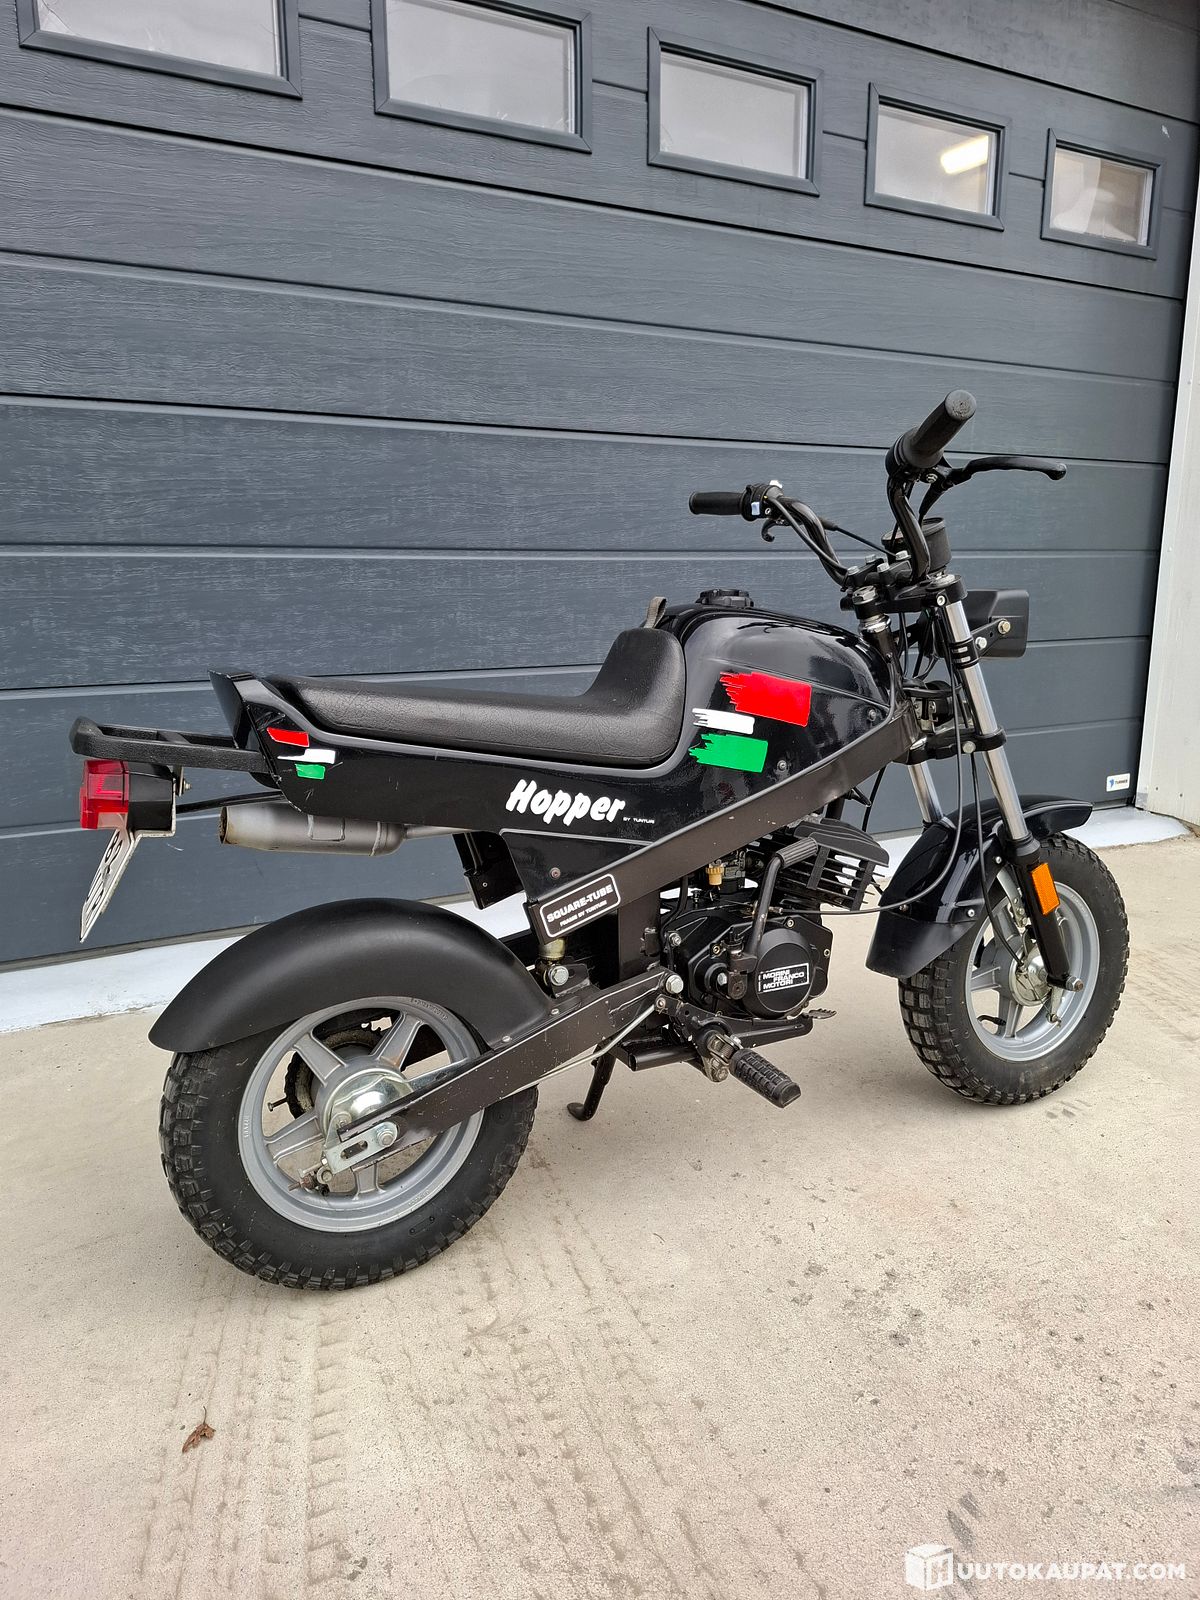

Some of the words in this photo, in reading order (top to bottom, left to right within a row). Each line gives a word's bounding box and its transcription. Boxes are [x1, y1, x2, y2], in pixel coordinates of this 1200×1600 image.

[505, 779, 626, 826] Hopper
[546, 884, 614, 923] SQUARE-TUBE
[577, 910, 585, 918] BY
[763, 970, 790, 980] MORINI
[773, 972, 804, 983] FRANCO
[763, 979, 793, 989] MOTORI
